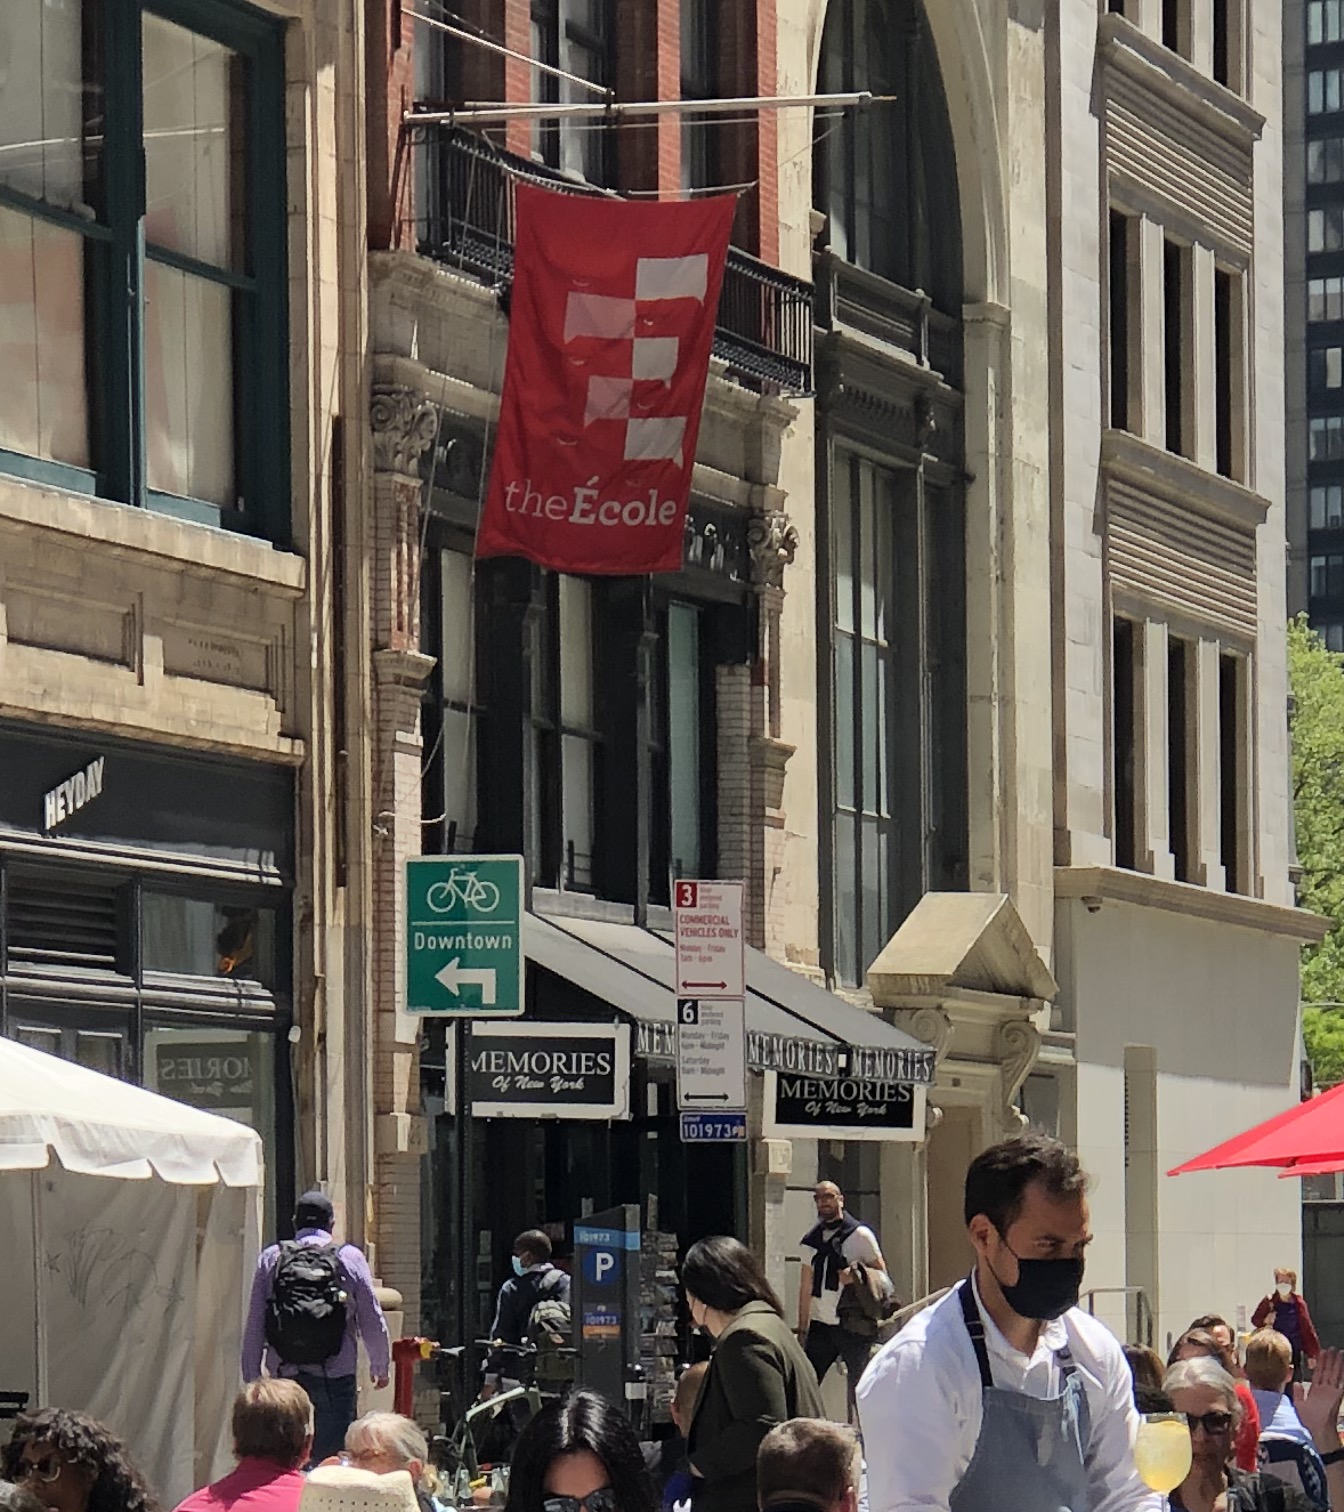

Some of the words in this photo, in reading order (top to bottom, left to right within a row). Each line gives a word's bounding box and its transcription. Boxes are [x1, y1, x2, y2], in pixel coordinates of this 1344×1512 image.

[44, 755, 105, 831] HEYDAY
[681, 884, 693, 907] 3
[679, 914, 730, 925] COMMERCIAL
[414, 932, 512, 950] Downtown
[680, 927, 716, 938] VEHICLES
[718, 927, 739, 938] ONLY
[682, 1002, 695, 1023] 6
[637, 1021, 675, 1055] MEM
[748, 1034, 834, 1075] MEMORIES
[852, 1048, 933, 1082] MEMORIES
[492, 1075, 511, 1092] Of
[514, 1075, 545, 1089] New
[549, 1076, 585, 1093] York
[780, 1079, 911, 1102] MEMORIES
[805, 1101, 822, 1116] Of
[825, 1101, 852, 1114] New
[856, 1101, 887, 1117] York
[684, 1123, 731, 1138] 101973
[596, 1252, 615, 1281] P
